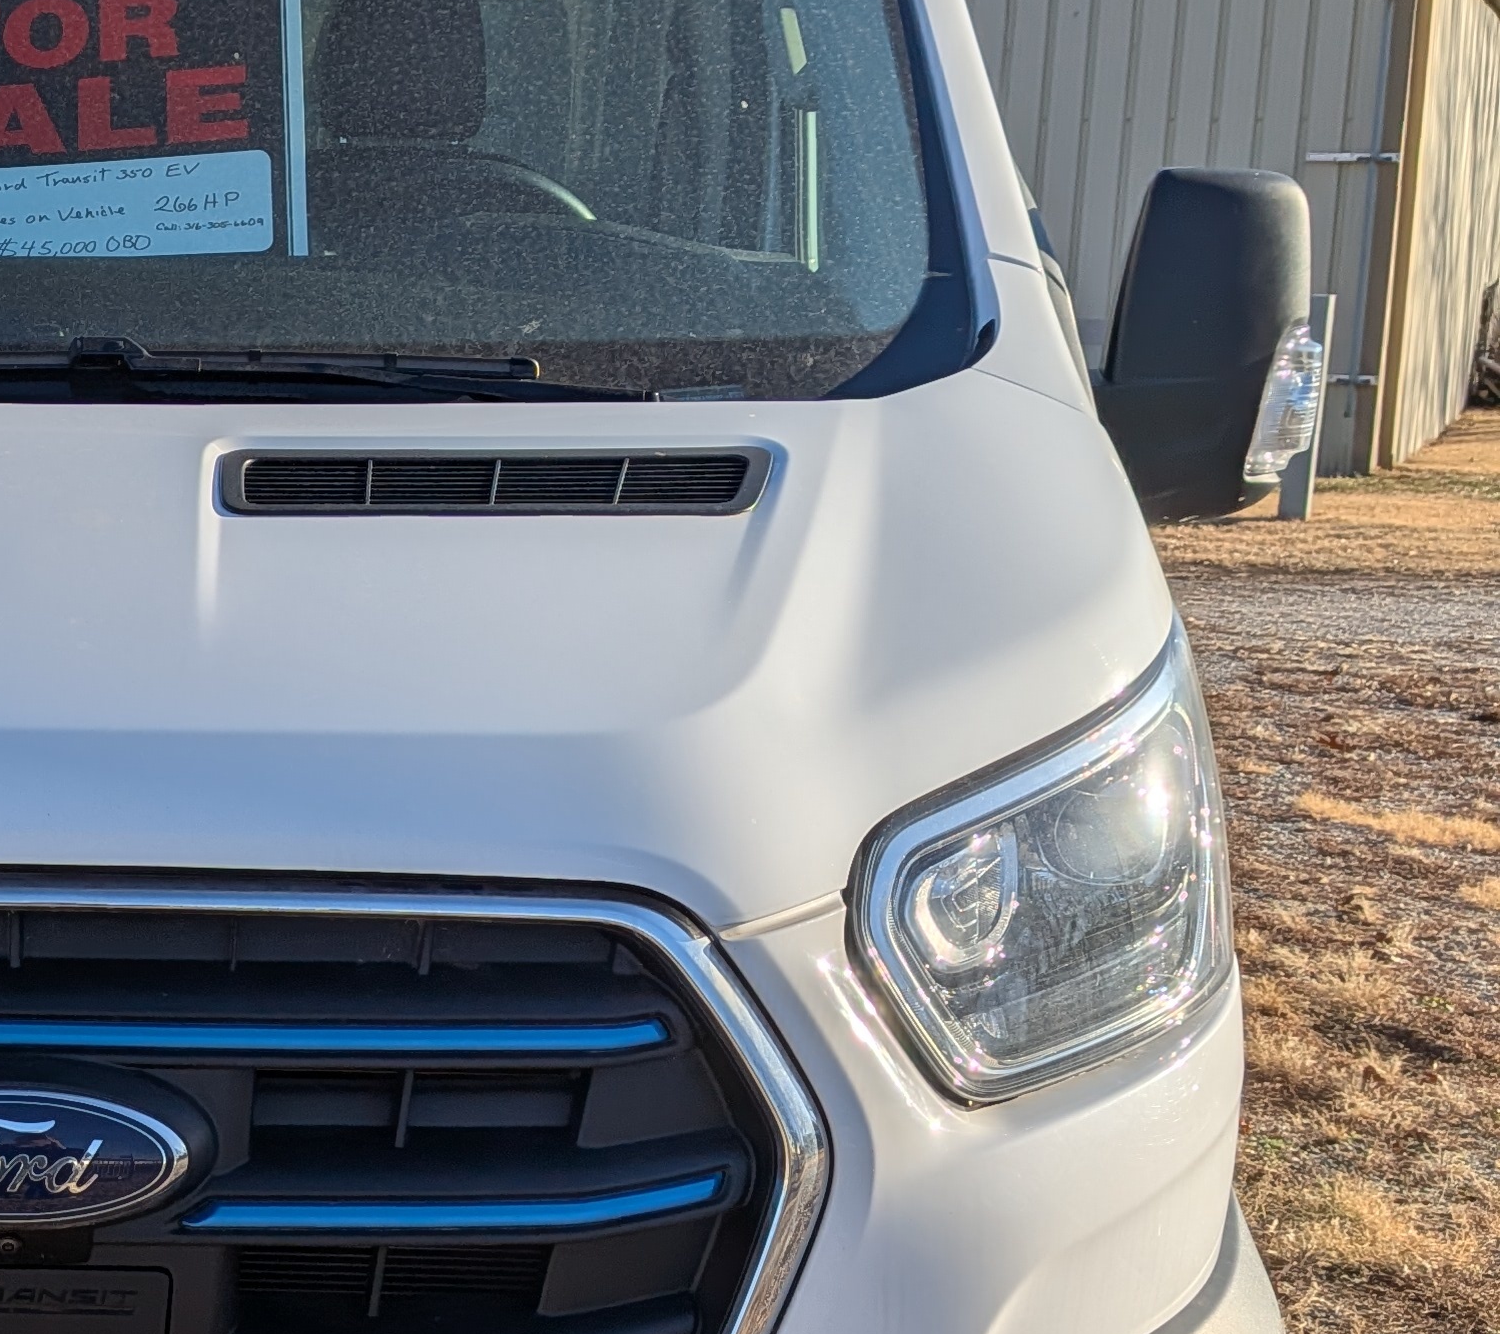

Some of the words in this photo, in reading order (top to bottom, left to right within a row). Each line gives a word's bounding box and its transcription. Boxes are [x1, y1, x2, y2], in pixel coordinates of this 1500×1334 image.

[36, 167, 112, 187] Transit
[116, 167, 153, 180] 350
[165, 162, 201, 177] EV
[153, 195, 198, 213] 266
[203, 191, 240, 211] HP
[25, 213, 50, 224] on
[56, 206, 126, 221] Vehicle
